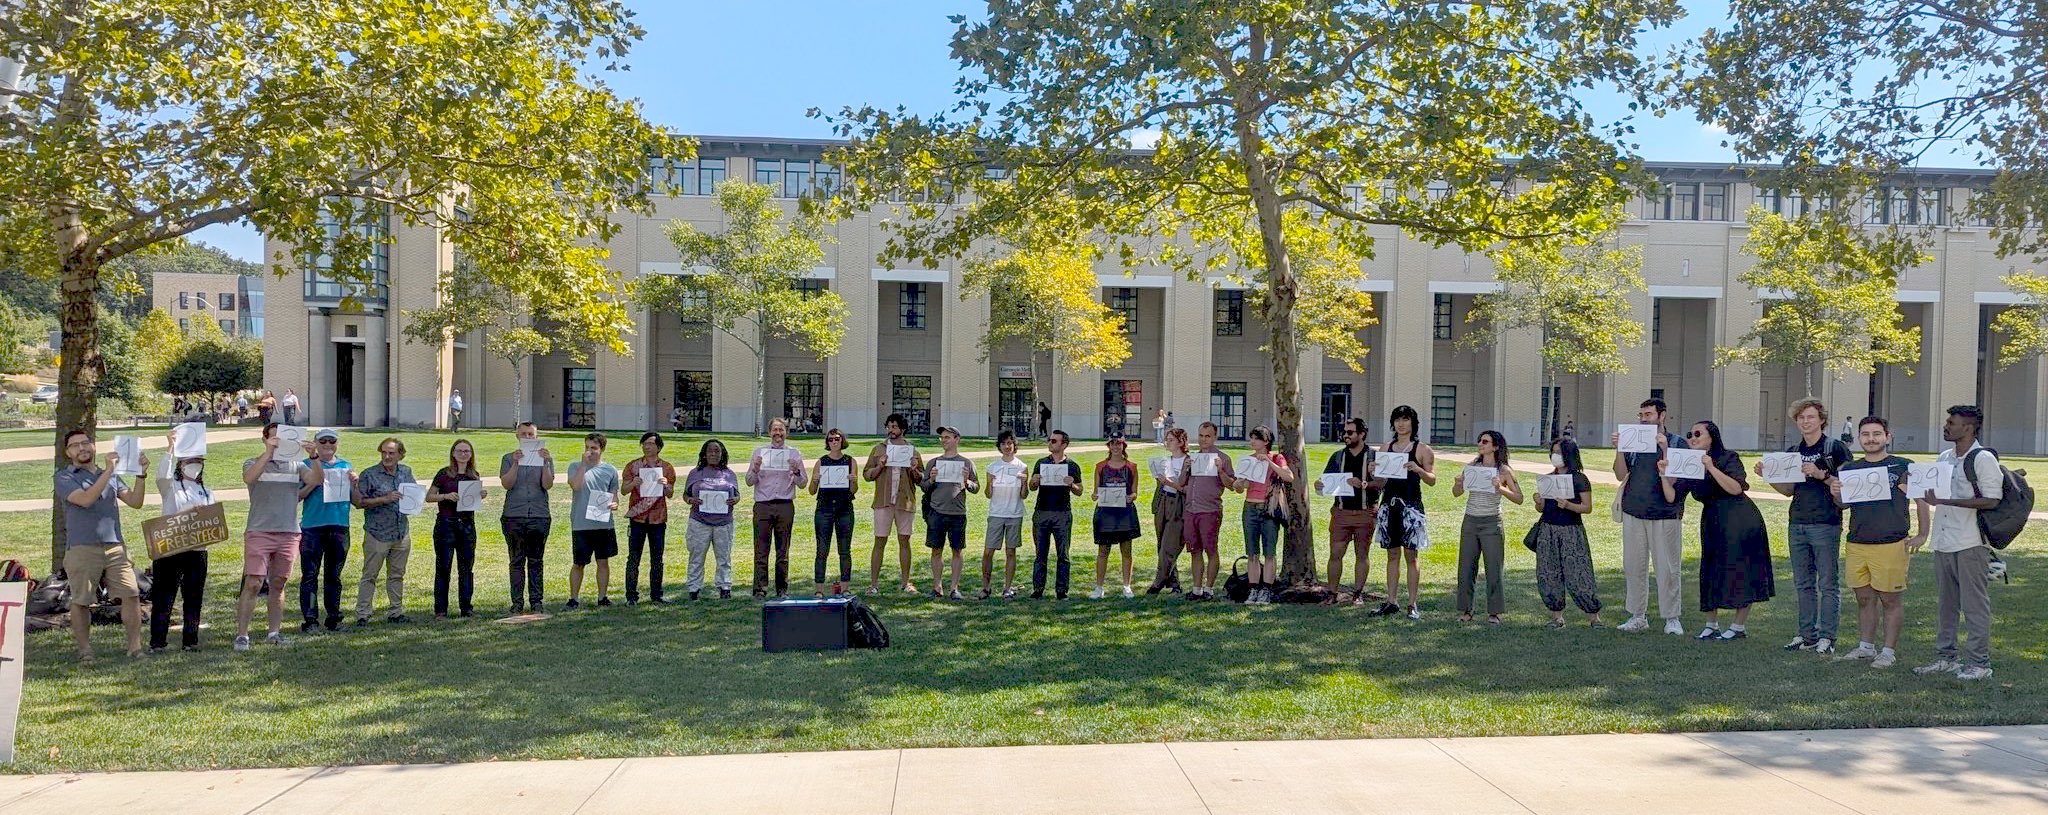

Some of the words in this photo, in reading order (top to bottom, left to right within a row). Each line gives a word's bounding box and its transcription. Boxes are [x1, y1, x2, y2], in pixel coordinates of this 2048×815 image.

[279, 428, 301, 457] 3
[1621, 427, 1652, 451] 25
[120, 438, 137, 473] 1
[888, 446, 911, 467] 13
[1378, 453, 1406, 477] 22
[1670, 453, 1699, 477] 26
[1763, 454, 1798, 479] 27
[823, 467, 848, 487] 12
[1238, 458, 1264, 483] 20
[1466, 468, 1494, 489] 23
[1908, 466, 1940, 488] 29
[461, 482, 477, 508] 6
[1100, 488, 1123, 504] 17
[1324, 474, 1352, 495] 21
[1539, 476, 1569, 497] 24
[1844, 471, 1884, 500] 28
[402, 484, 418, 511] 5
[153, 517, 220, 540] RESTRICTING
[166, 512, 198, 526] STOP
[156, 534, 190, 554] FREE
[193, 525, 226, 544] SPEECH
